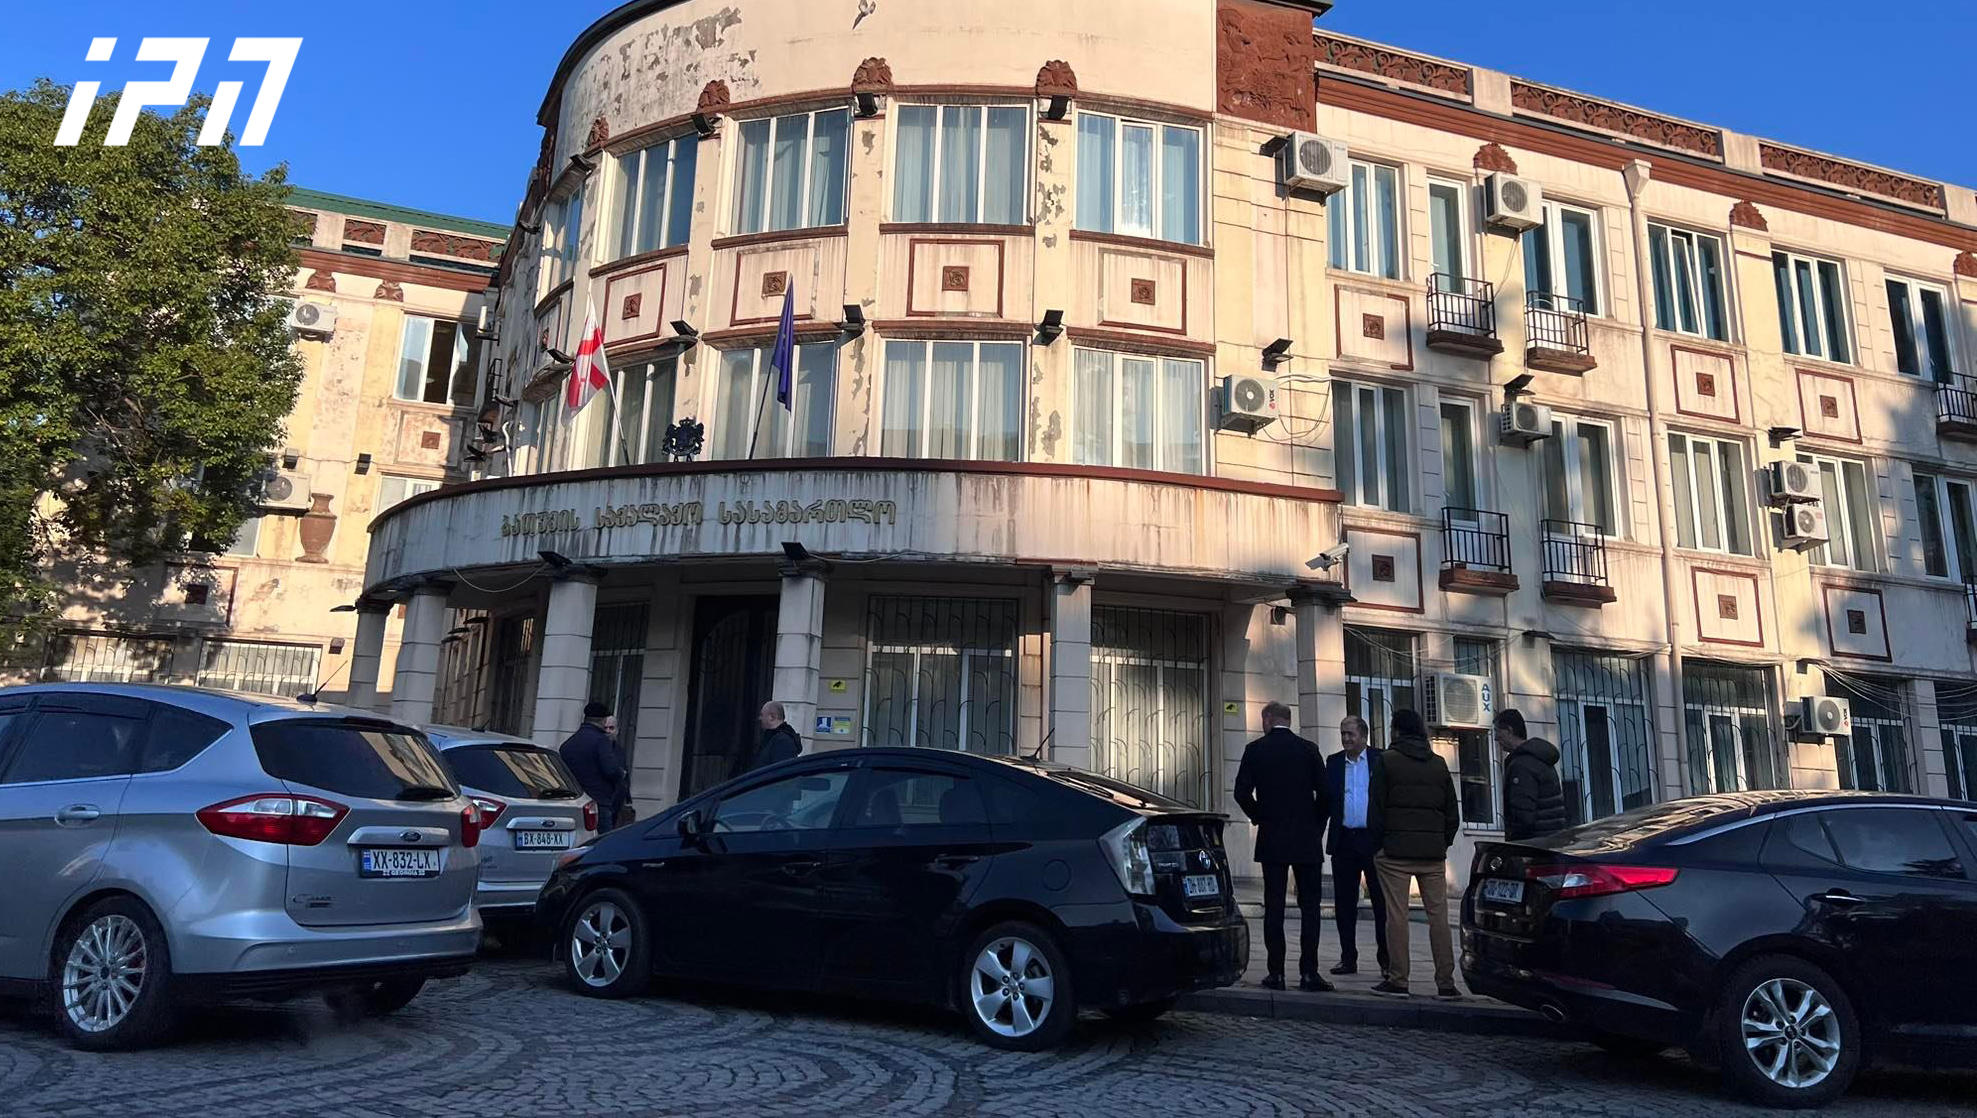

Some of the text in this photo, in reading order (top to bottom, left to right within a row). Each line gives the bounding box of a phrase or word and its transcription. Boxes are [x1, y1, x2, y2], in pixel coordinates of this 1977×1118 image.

[501, 499, 897, 538] ბათუმის საქალაქო სასამართლო
[1481, 683, 1491, 712] AUX
[523, 832, 563, 845] BX-848-XX
[373, 850, 431, 870] XX-832-LX
